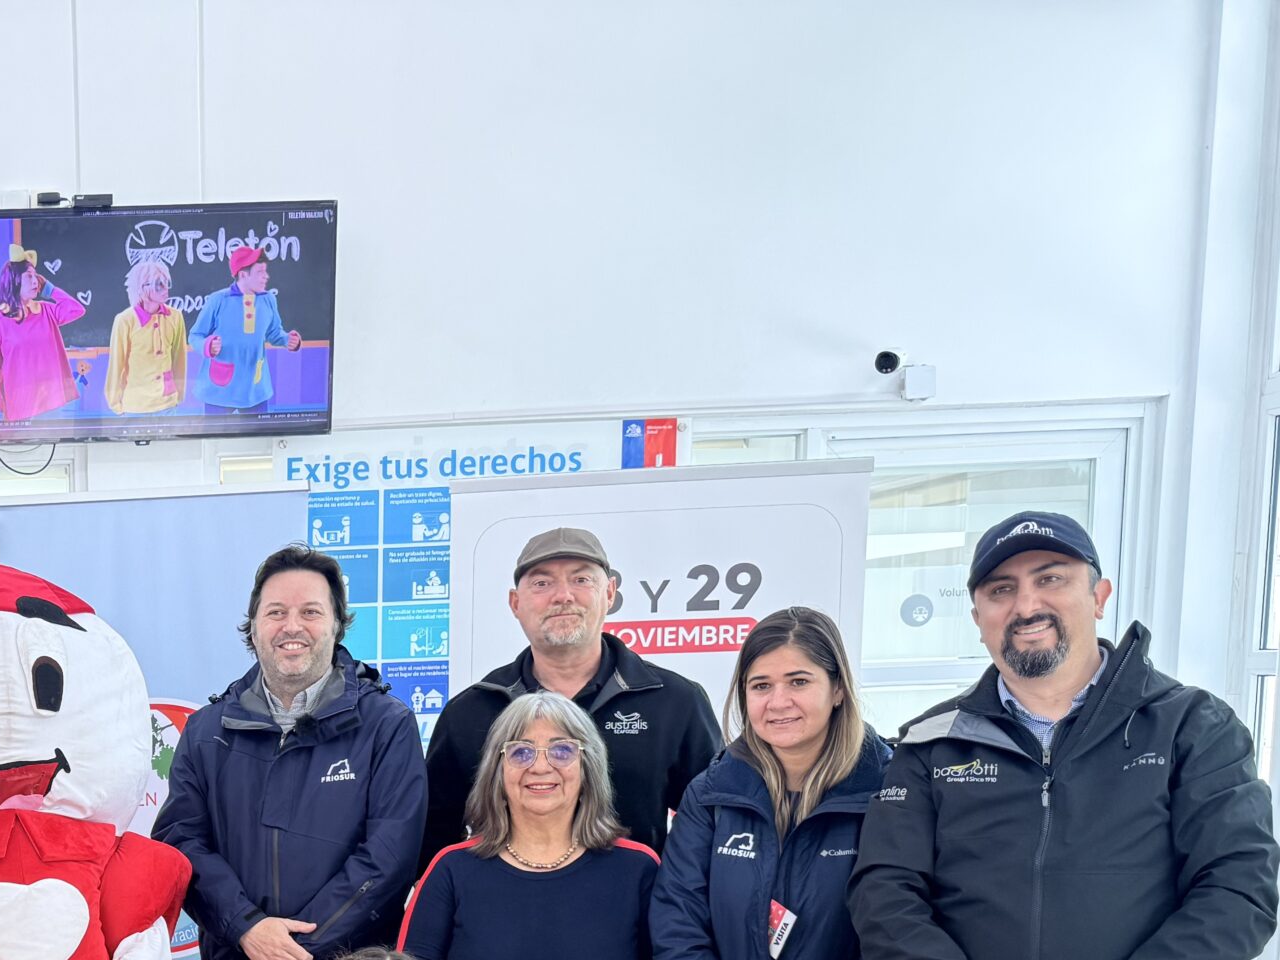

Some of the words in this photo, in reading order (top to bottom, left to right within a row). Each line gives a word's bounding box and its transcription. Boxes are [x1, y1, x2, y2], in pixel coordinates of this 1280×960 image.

[286, 457, 370, 489] Exige
[380, 455, 429, 479] tus
[438, 447, 582, 477] derechos
[639, 580, 671, 613] Y
[686, 562, 763, 612] 29
[321, 773, 356, 783] FRIOSUR
[717, 846, 756, 860] FRIOSUR
[773, 921, 789, 946] VISITA
